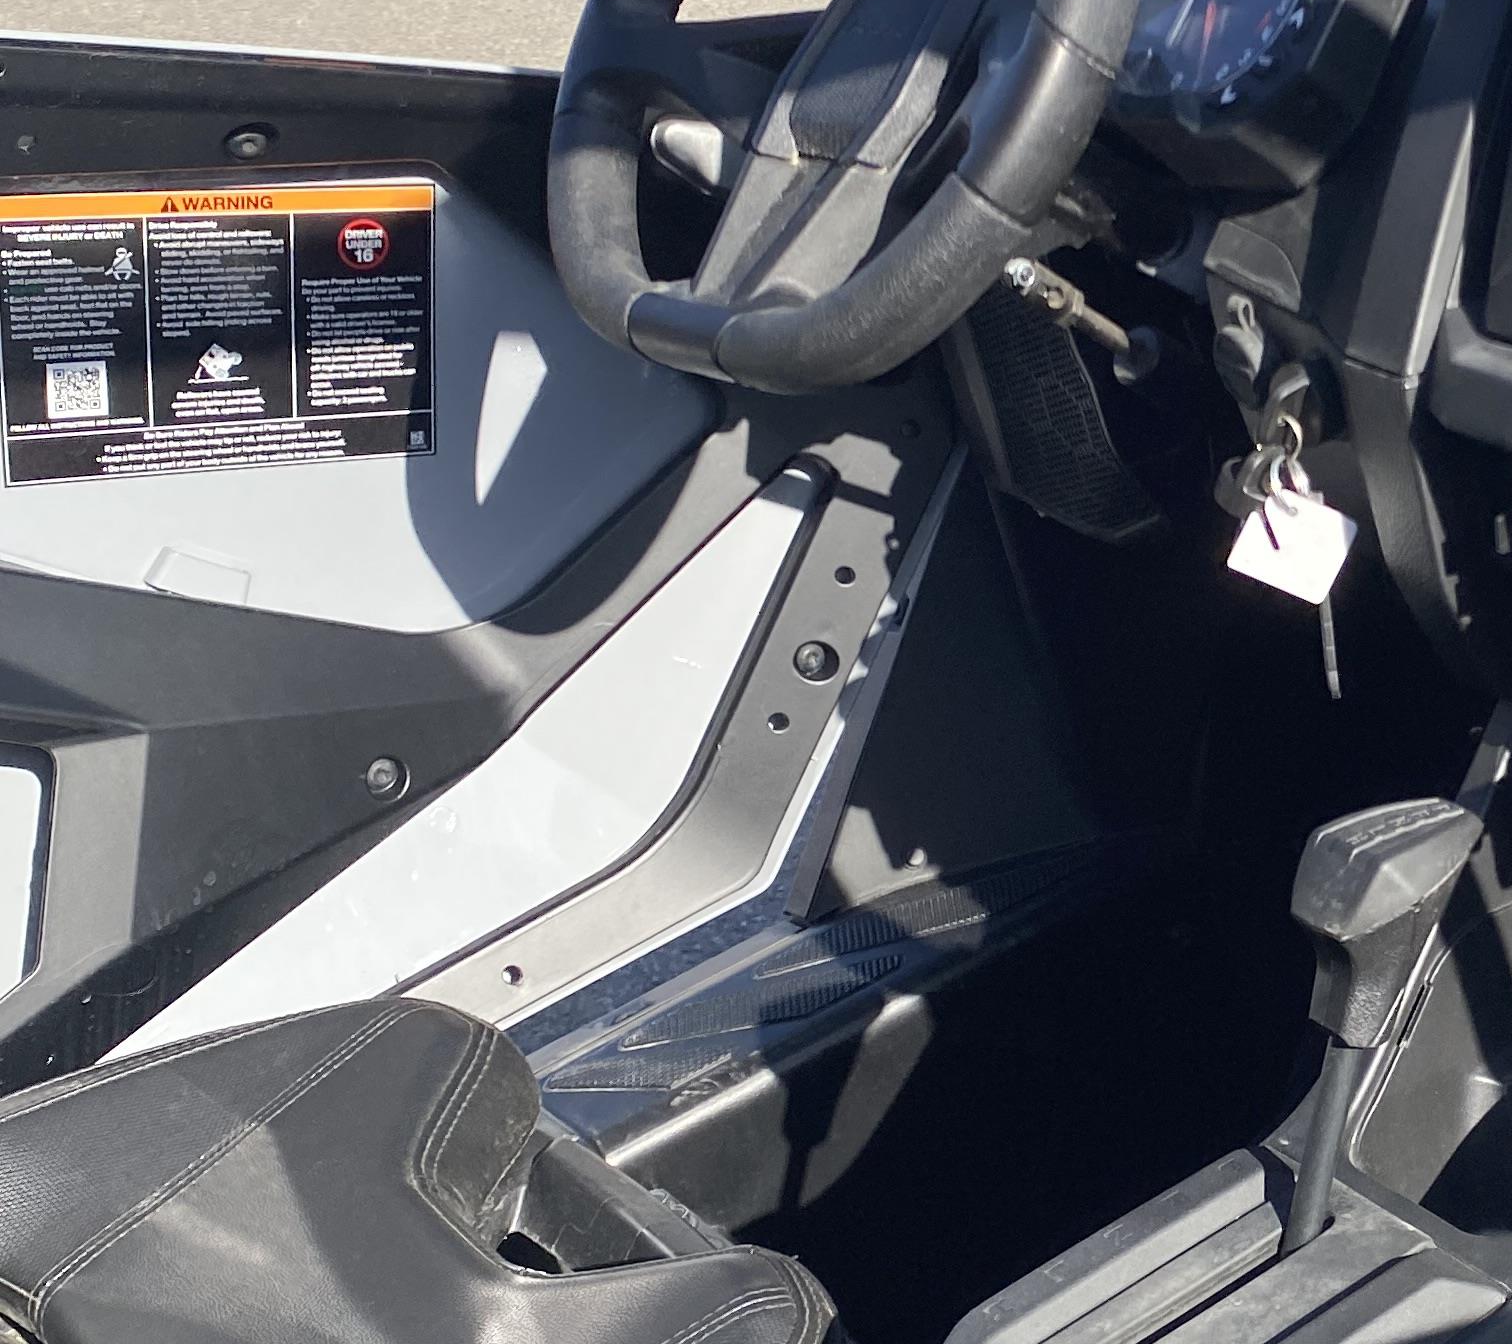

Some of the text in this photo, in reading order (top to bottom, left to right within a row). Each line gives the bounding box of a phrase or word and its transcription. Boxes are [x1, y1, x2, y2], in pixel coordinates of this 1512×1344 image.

[183, 196, 273, 211] WARNING
[17, 233, 51, 242] SEVERE
[52, 232, 83, 241] INJURY
[94, 231, 123, 240] DEATH
[345, 229, 384, 239] DRIVER
[345, 239, 382, 249] UNDER
[354, 249, 374, 263] 16
